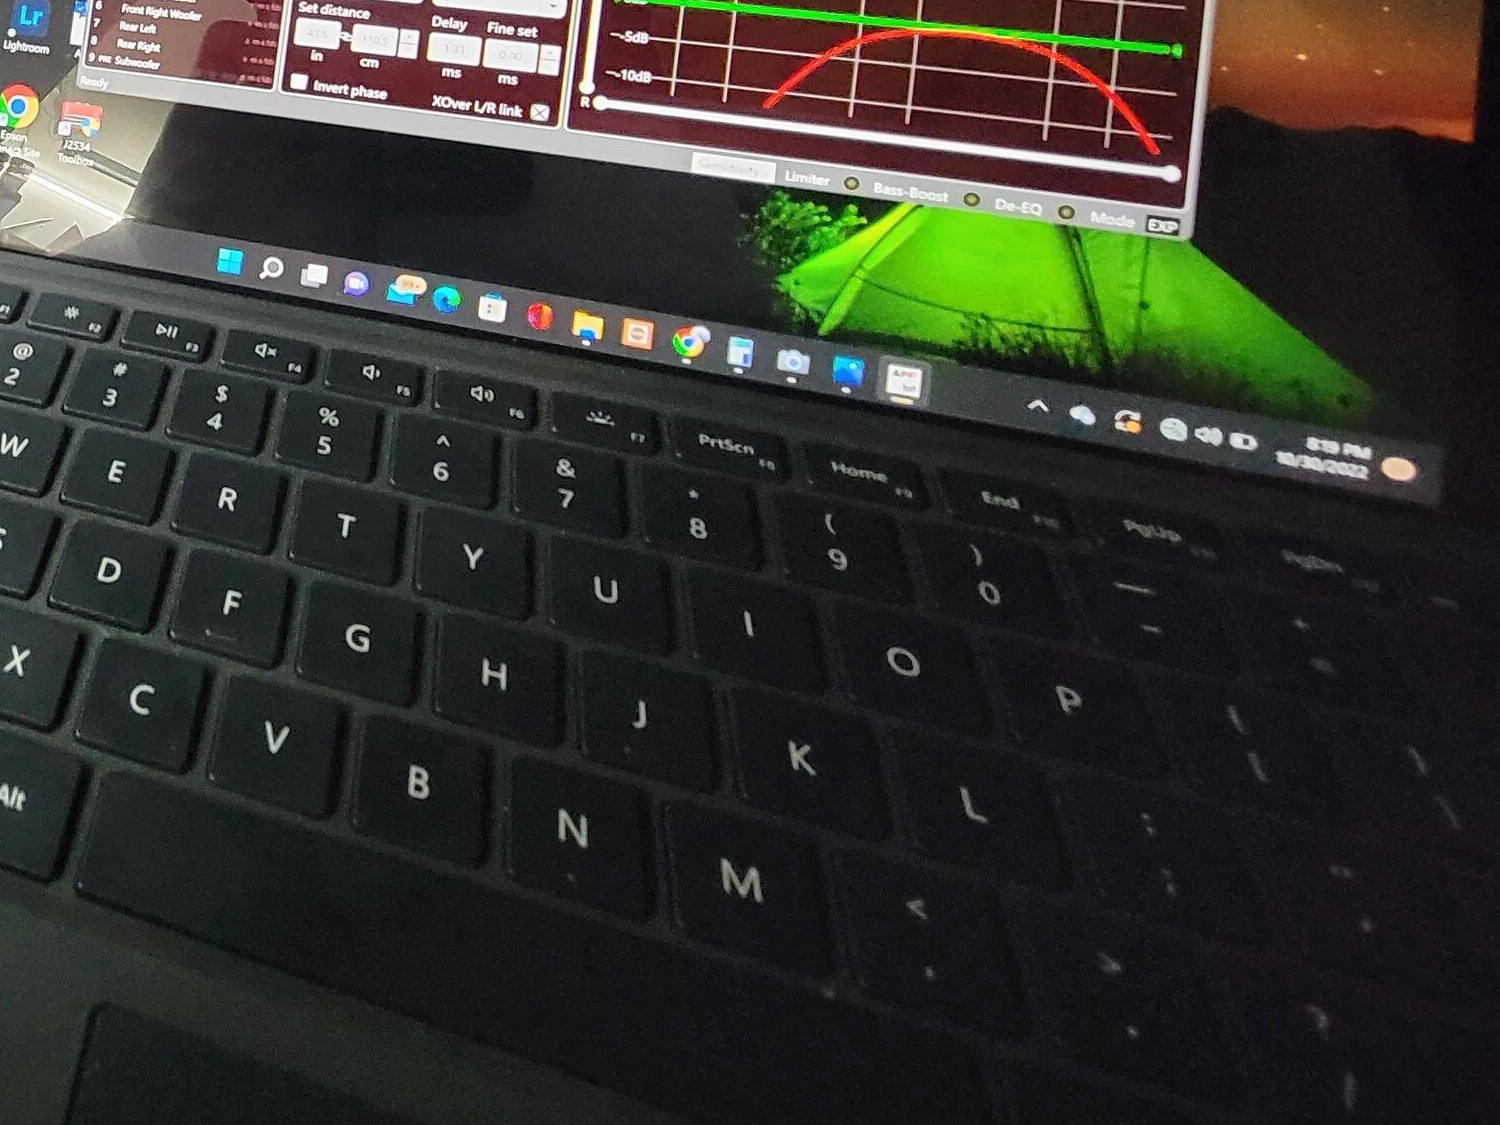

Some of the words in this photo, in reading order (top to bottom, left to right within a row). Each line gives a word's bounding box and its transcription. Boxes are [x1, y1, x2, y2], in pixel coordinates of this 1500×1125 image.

[20, 5, 43, 27] Lr
[432, 15, 468, 33] Delay
[488, 21, 514, 35] Fine
[517, 25, 538, 38] set
[3, 40, 50, 55] Lightroom
[80, 76, 109, 90] Ready
[0, 130, 28, 144] Epson
[63, 140, 91, 152] J2534
[785, 170, 830, 188] Limiter
[0, 433, 29, 457] W
[699, 433, 755, 455] PrtScn
[108, 461, 127, 483] E
[831, 461, 888, 483] Home
[218, 486, 236, 511] R
[337, 513, 356, 538] T
[463, 543, 484, 569] Y
[98, 558, 121, 583] D
[223, 589, 242, 614] F
[594, 576, 618, 603] U
[345, 624, 370, 652] G
[4, 646, 30, 676] X
[888, 647, 920, 676] O
[482, 658, 507, 690] H
[130, 685, 154, 715] C
[1056, 685, 1082, 714] P
[632, 700, 647, 728] J
[265, 720, 290, 754] V
[789, 740, 816, 775] K
[409, 765, 429, 799] B
[960, 786, 987, 823] L
[558, 808, 588, 848] N
[720, 858, 763, 903] M
